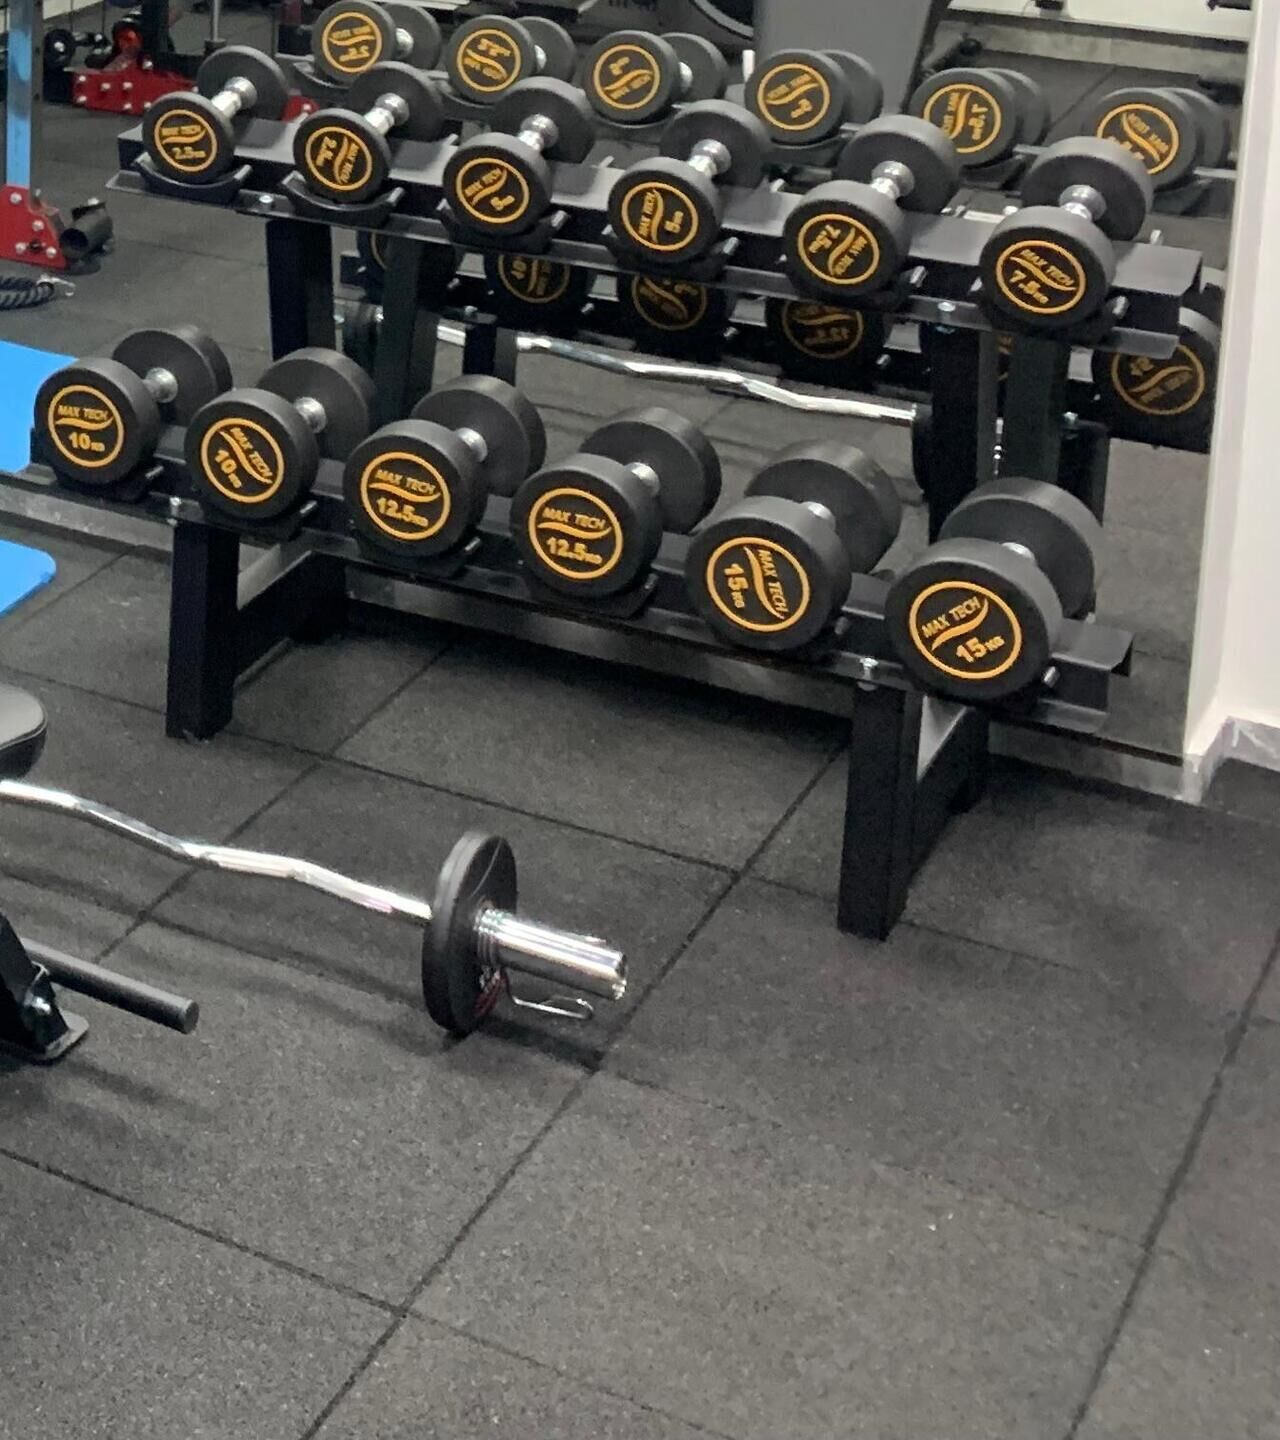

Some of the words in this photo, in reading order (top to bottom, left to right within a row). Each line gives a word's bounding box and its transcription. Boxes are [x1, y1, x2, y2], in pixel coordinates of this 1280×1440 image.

[1020, 249, 1048, 266] MAX
[1047, 265, 1075, 286] TECH
[57, 404, 81, 418] MAX
[82, 407, 108, 421] TECH
[230, 427, 253, 450] MAX
[249, 451, 273, 477] TECH
[374, 469, 403, 484] MAX
[406, 477, 436, 494] TECH
[541, 506, 571, 523] MAX
[574, 513, 606, 530] TECH
[757, 548, 777, 579] MAX
[768, 580, 789, 613] TECH
[921, 613, 950, 638] MAX
[949, 596, 981, 621] TECH
